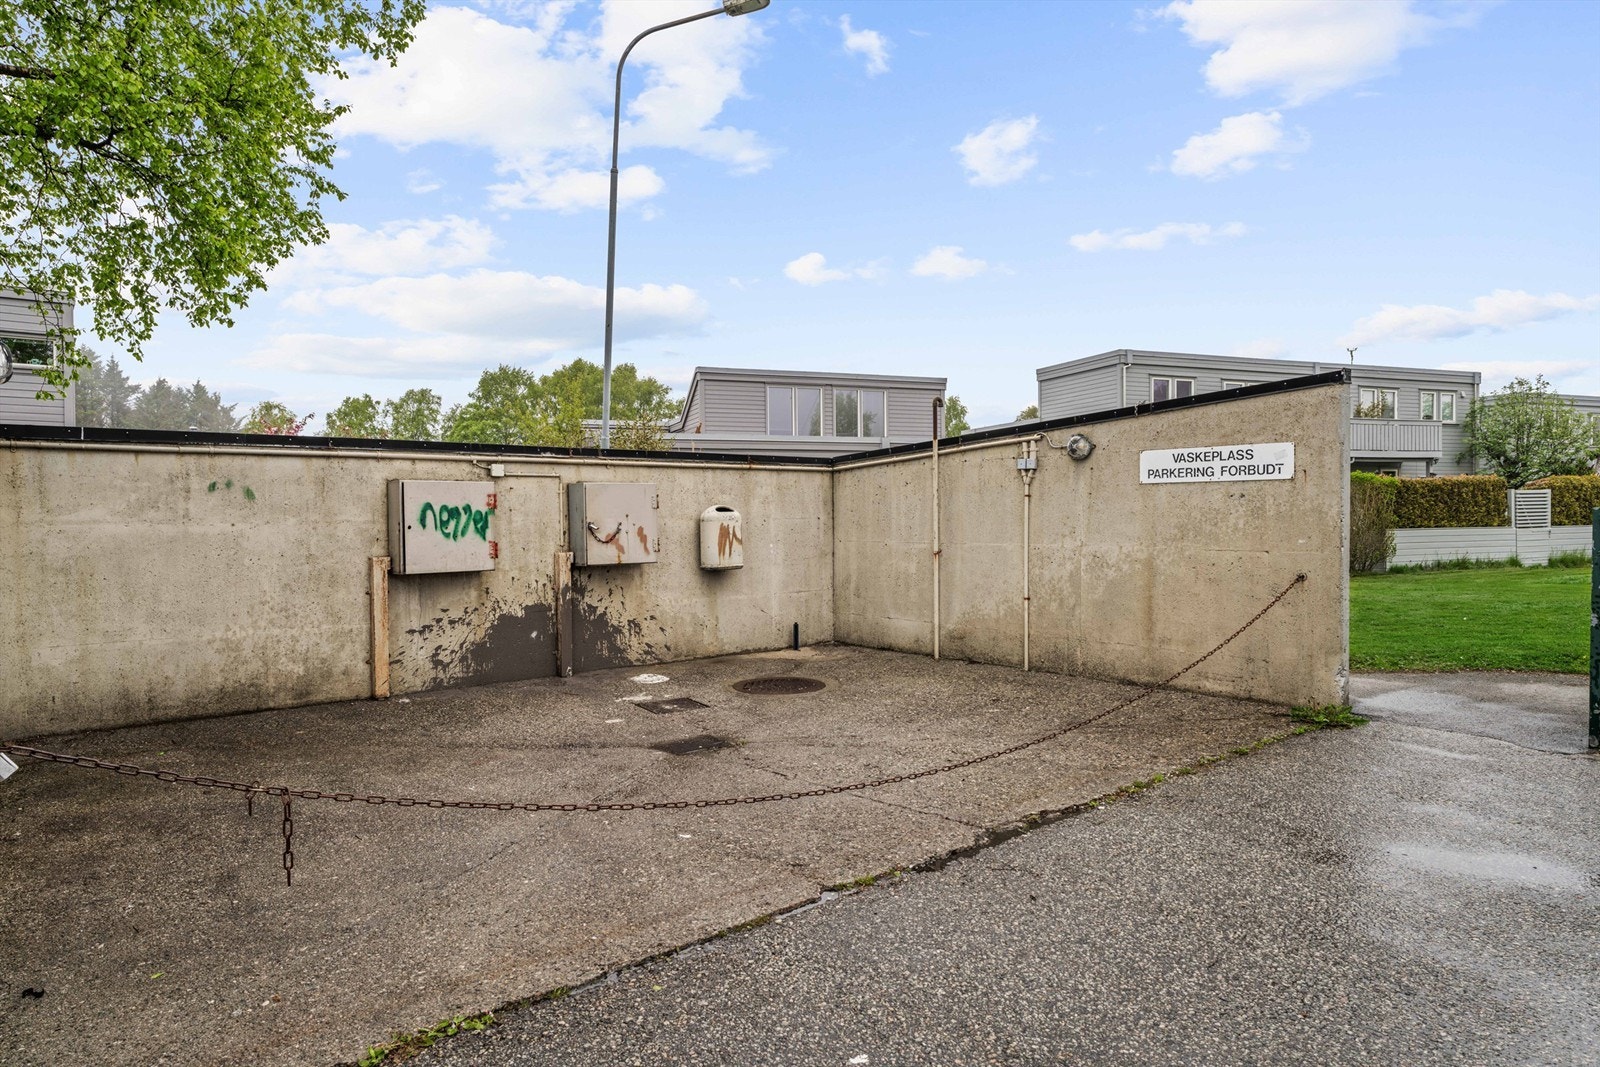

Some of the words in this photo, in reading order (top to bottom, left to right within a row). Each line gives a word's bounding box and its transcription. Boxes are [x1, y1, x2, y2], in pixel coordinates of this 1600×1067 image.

[1172, 449, 1254, 463] VASKEPLASS
[1147, 467, 1215, 479] PARKERING
[1220, 463, 1284, 477] FORBUDT
